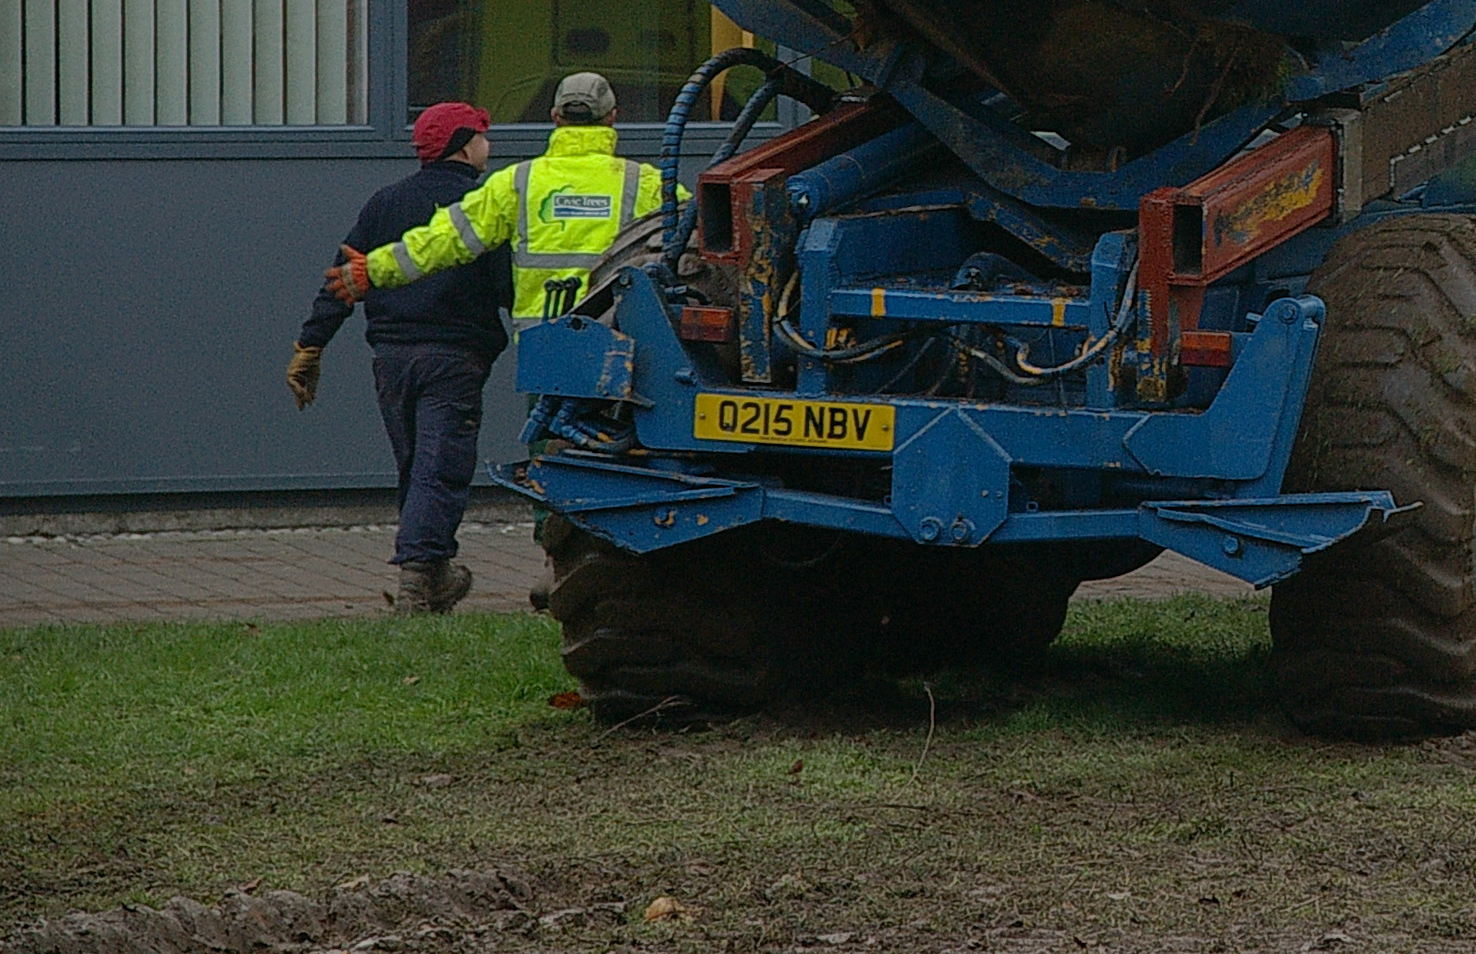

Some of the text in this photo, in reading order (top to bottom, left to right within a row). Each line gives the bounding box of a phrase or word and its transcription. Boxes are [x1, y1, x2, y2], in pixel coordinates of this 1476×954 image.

[555, 196, 608, 207] Civic Trees
[719, 400, 871, 441] Q215 NBV
